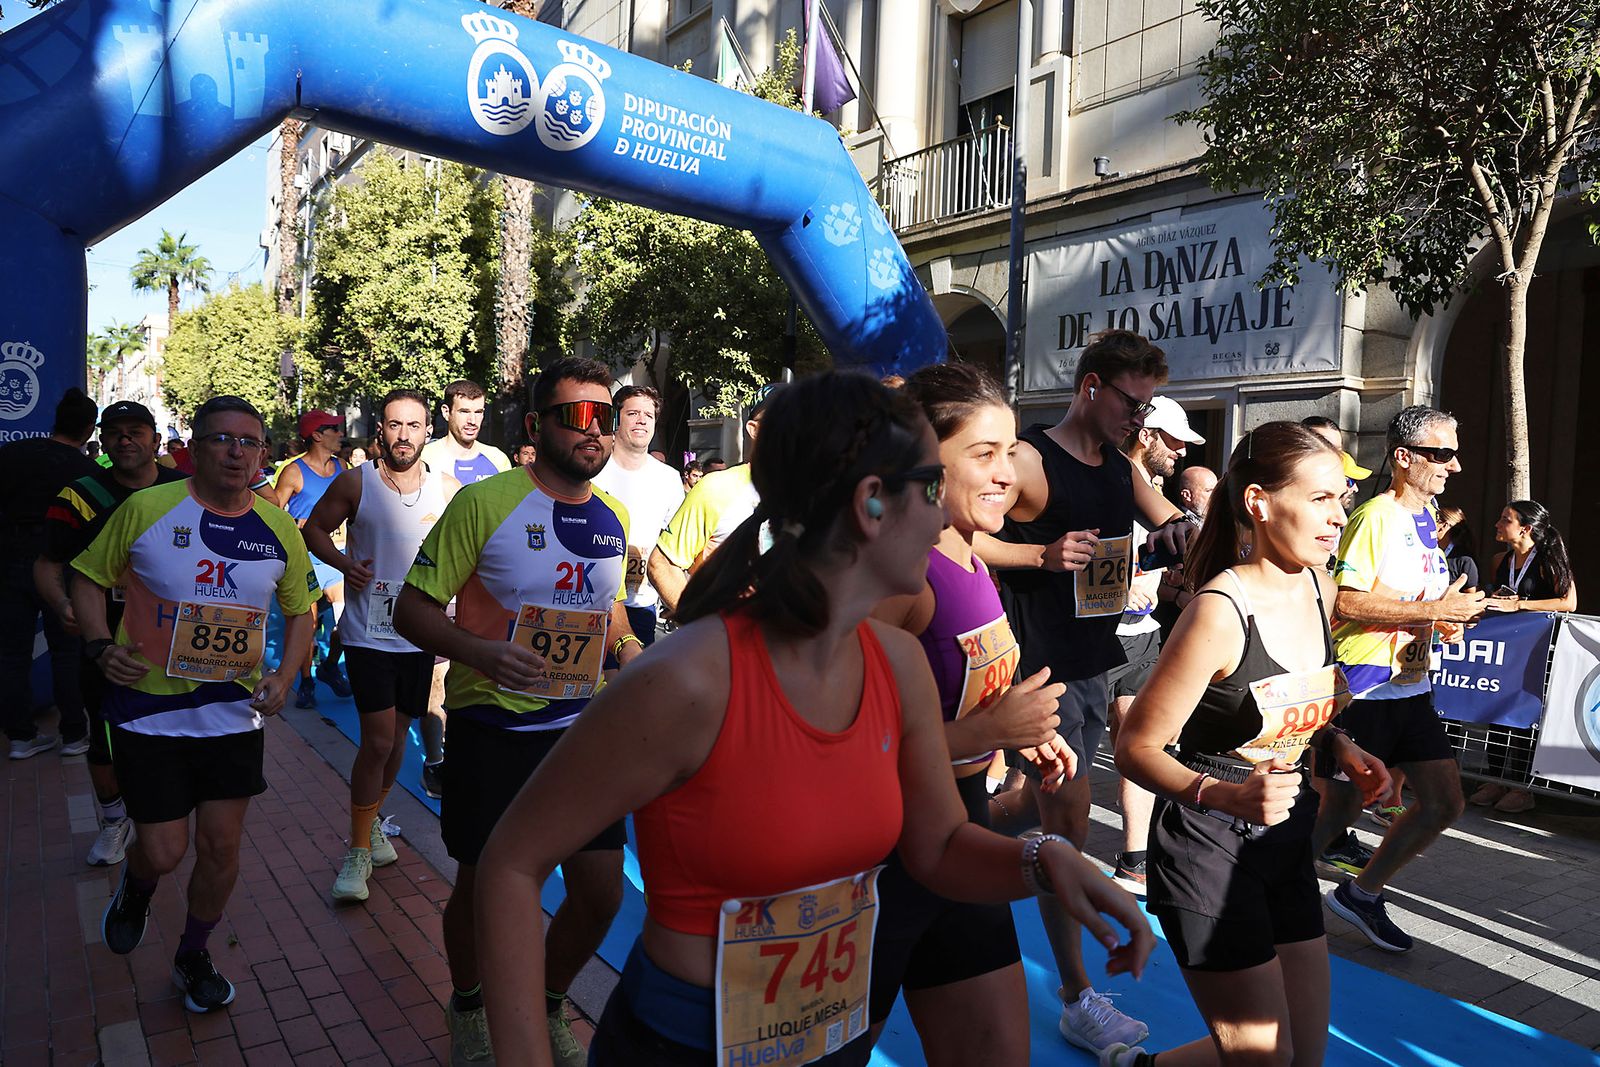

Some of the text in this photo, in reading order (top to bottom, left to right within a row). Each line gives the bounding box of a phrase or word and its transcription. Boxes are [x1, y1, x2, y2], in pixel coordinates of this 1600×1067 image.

[623, 92, 732, 141] DIPUTACIÓN
[620, 114, 727, 161] PROVINCIAL
[632, 142, 701, 176] HUELVA
[1136, 223, 1217, 249] AGUS DÍAZ VÁZQUEZ
[1099, 236, 1245, 297] LA DANZA
[1057, 312, 1093, 350] DE
[1148, 285, 1295, 345] SALVAJE
[0, 430, 54, 442] ROVIN
[237, 540, 278, 555] AVATEL
[195, 559, 239, 590] 21K
[555, 561, 597, 594] 21K
[194, 585, 238, 600] HUELVA
[552, 592, 594, 605] HUELVA
[1080, 599, 1114, 610] Huelva
[383, 597, 394, 617] 1
[191, 624, 249, 655] 858
[531, 631, 591, 666] 937
[1405, 642, 1430, 663] 90
[1442, 639, 1506, 666] DAI
[177, 654, 227, 667] CHAMORRO
[549, 672, 589, 681] REDONDO
[1432, 668, 1500, 692] rluz.es
[1272, 738, 1298, 749] TINEZ
[734, 924, 776, 938] HUELVA
[759, 920, 858, 1005] 745
[758, 1015, 811, 1041] LUQUE
[814, 998, 848, 1024] MESA
[728, 1036, 806, 1067] Huelva
